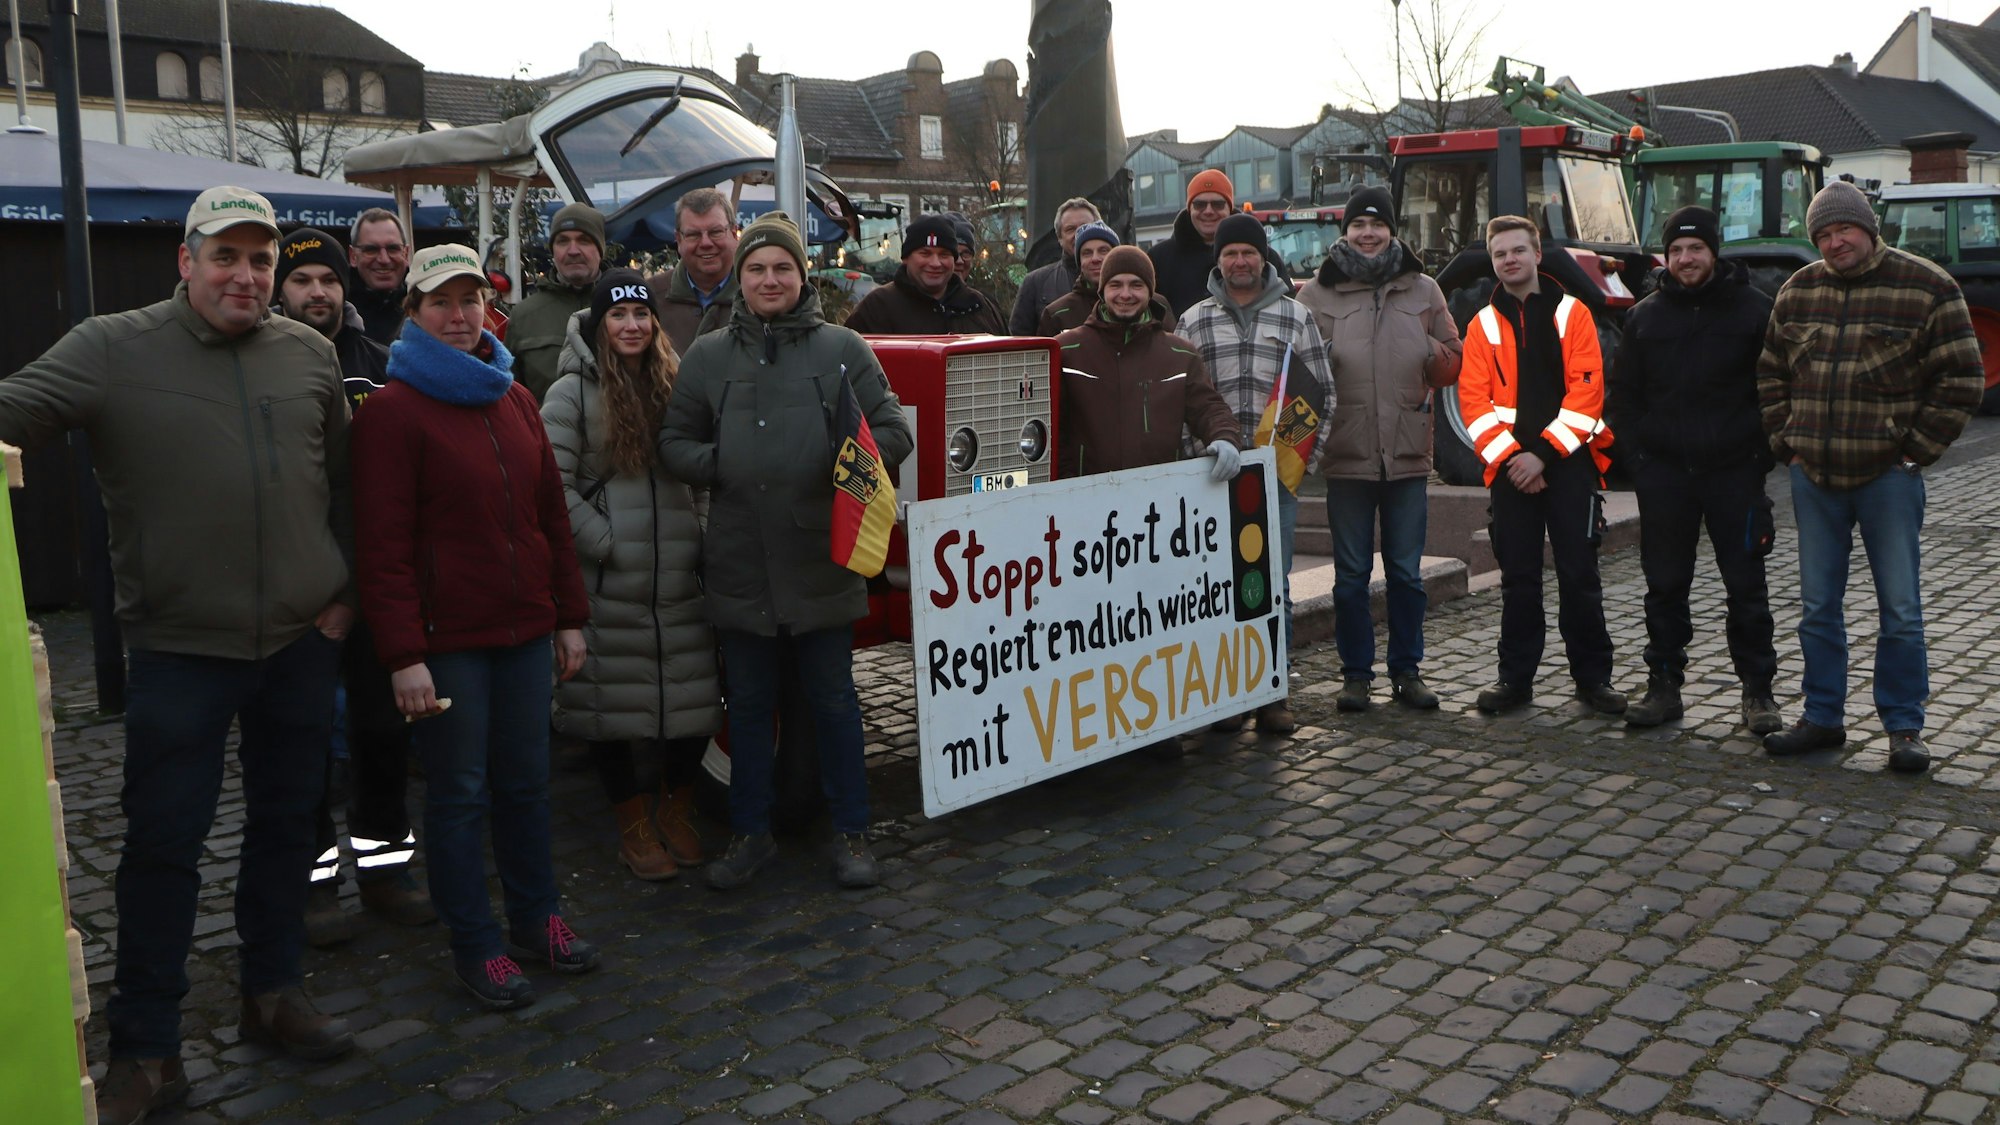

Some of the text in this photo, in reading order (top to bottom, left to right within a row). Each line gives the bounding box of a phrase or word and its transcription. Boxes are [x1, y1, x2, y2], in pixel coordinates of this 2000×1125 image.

[210, 199, 268, 218] Landwirt
[422, 254, 478, 271] Landwirtin
[610, 284, 650, 302] DKS
[986, 474, 1003, 491] BM
[929, 496, 1219, 616] Stoppt sofort die
[928, 571, 1231, 697] Regiert endlich wieder
[942, 703, 1010, 779] mit
